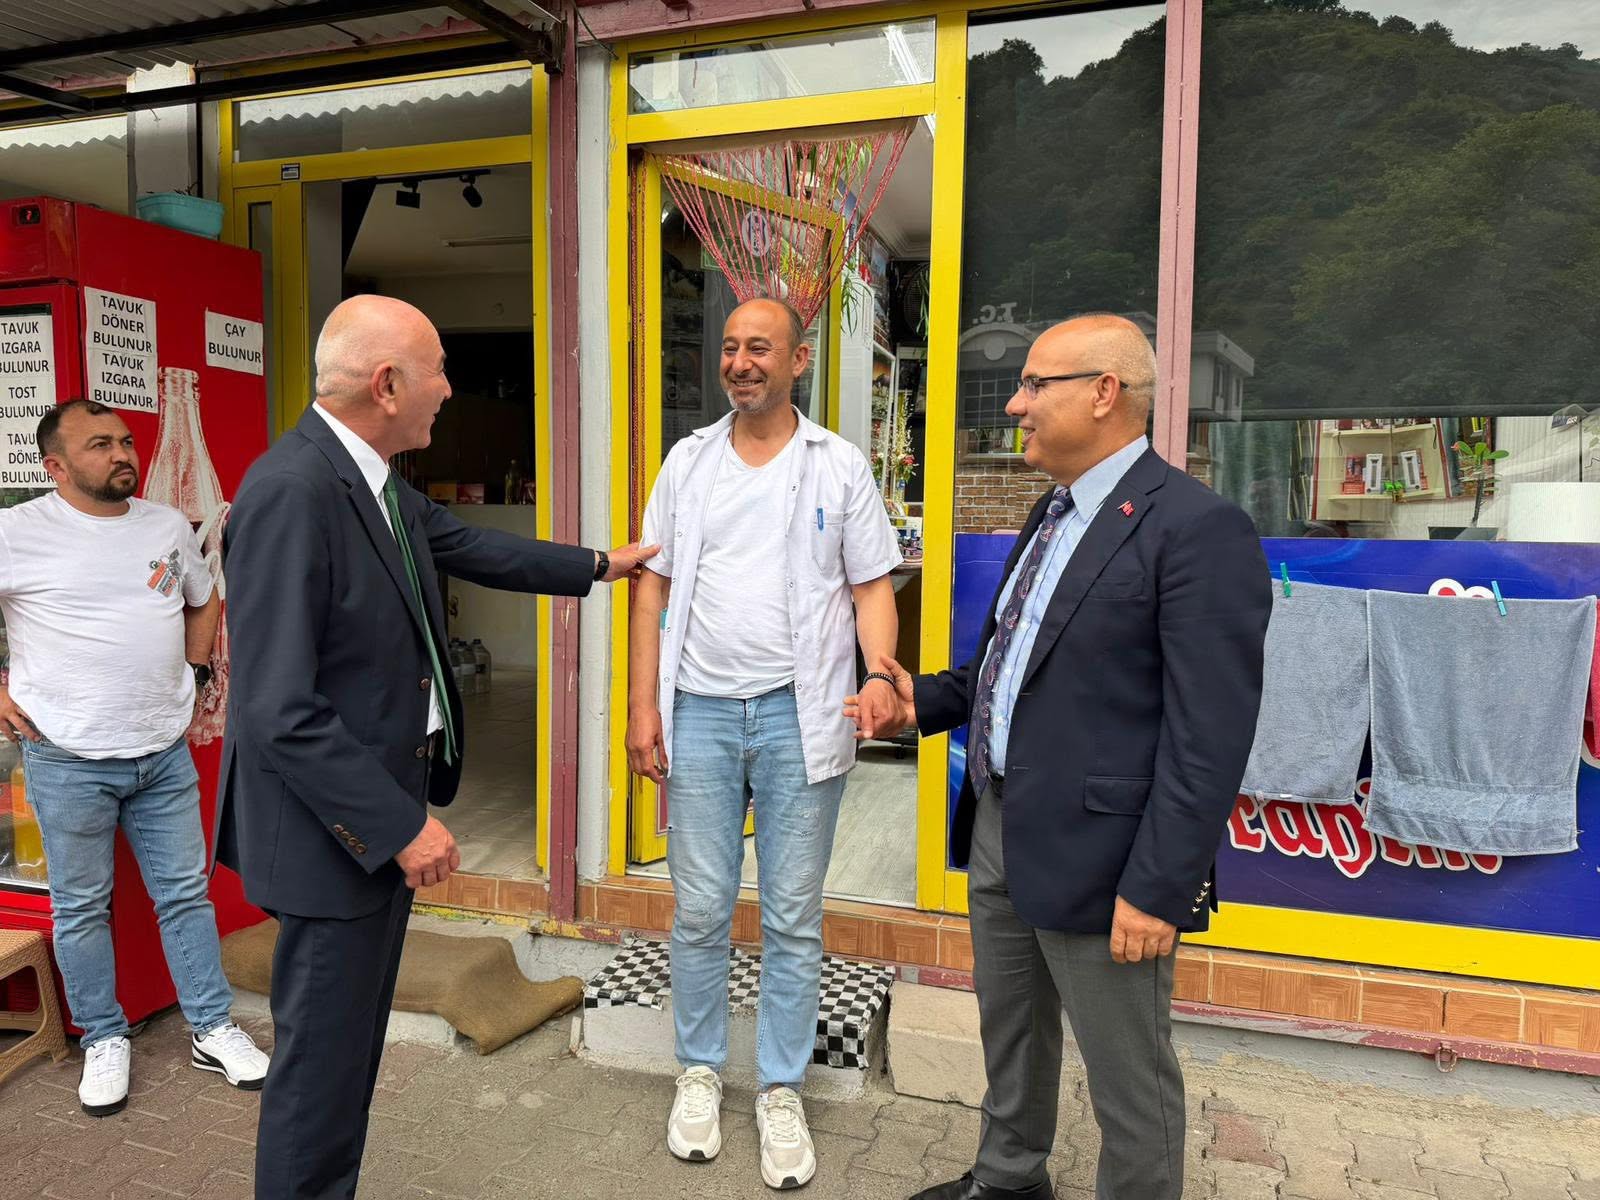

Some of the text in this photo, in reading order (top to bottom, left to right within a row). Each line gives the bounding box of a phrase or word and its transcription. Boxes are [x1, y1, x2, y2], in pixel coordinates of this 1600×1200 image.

[101, 295, 143, 315] TAVUK
[1, 321, 39, 335] TAVUK
[102, 313, 144, 333] DÖNER
[225, 322, 246, 338] ÇAY
[1, 340, 41, 355] IZGARA
[93, 331, 152, 353] BULUNUR
[208, 341, 261, 364] BULUNUR
[0, 360, 49, 374] ULUNUR
[102, 353, 143, 371] TAVUK
[102, 371, 146, 390] IZGARA
[8, 386, 37, 399] TOST
[94, 389, 153, 408] BULUNUR
[7, 433, 37, 445] TAVU
